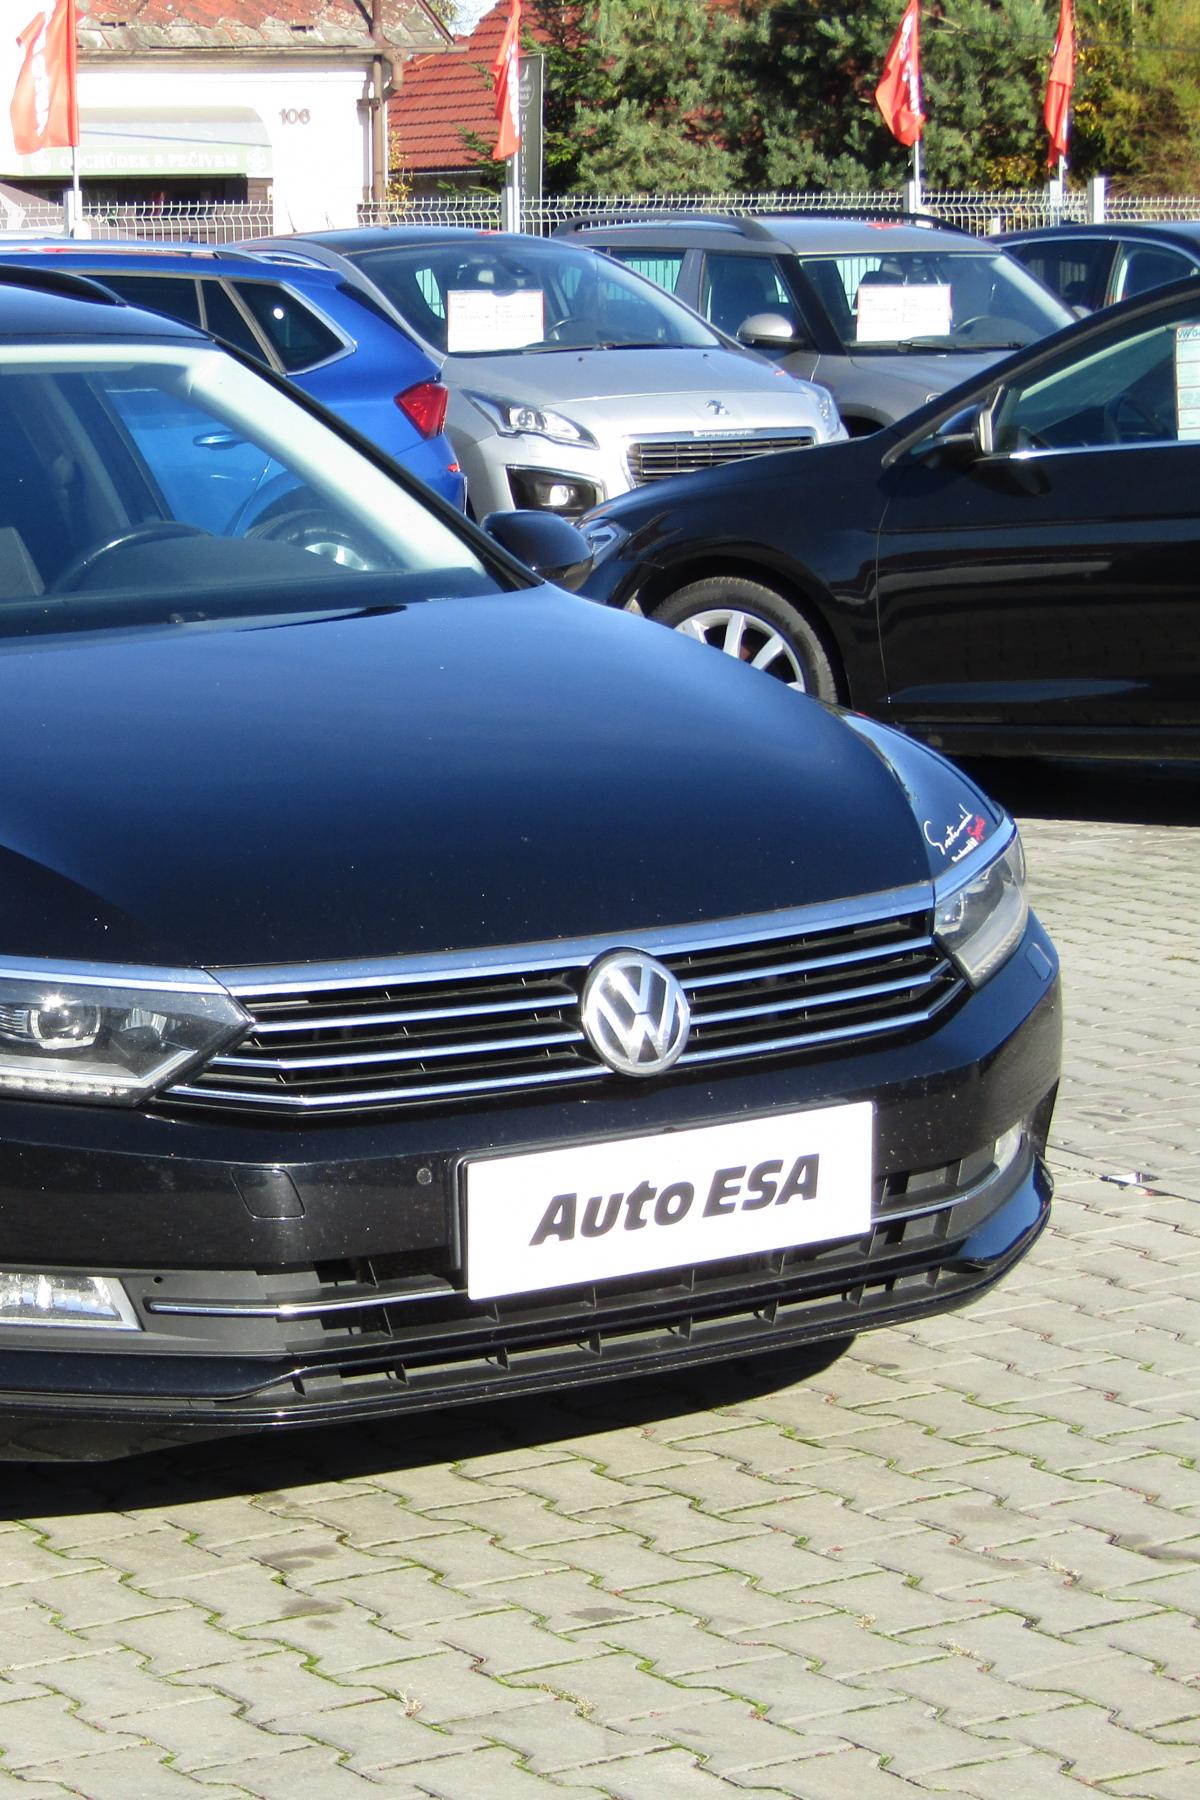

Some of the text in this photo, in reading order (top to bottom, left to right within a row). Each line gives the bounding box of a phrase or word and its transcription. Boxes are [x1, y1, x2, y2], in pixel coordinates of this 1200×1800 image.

[278, 108, 311, 125] 106
[59, 151, 148, 168] OCHŮDEK
[528, 1153, 820, 1247] Auto ESA
